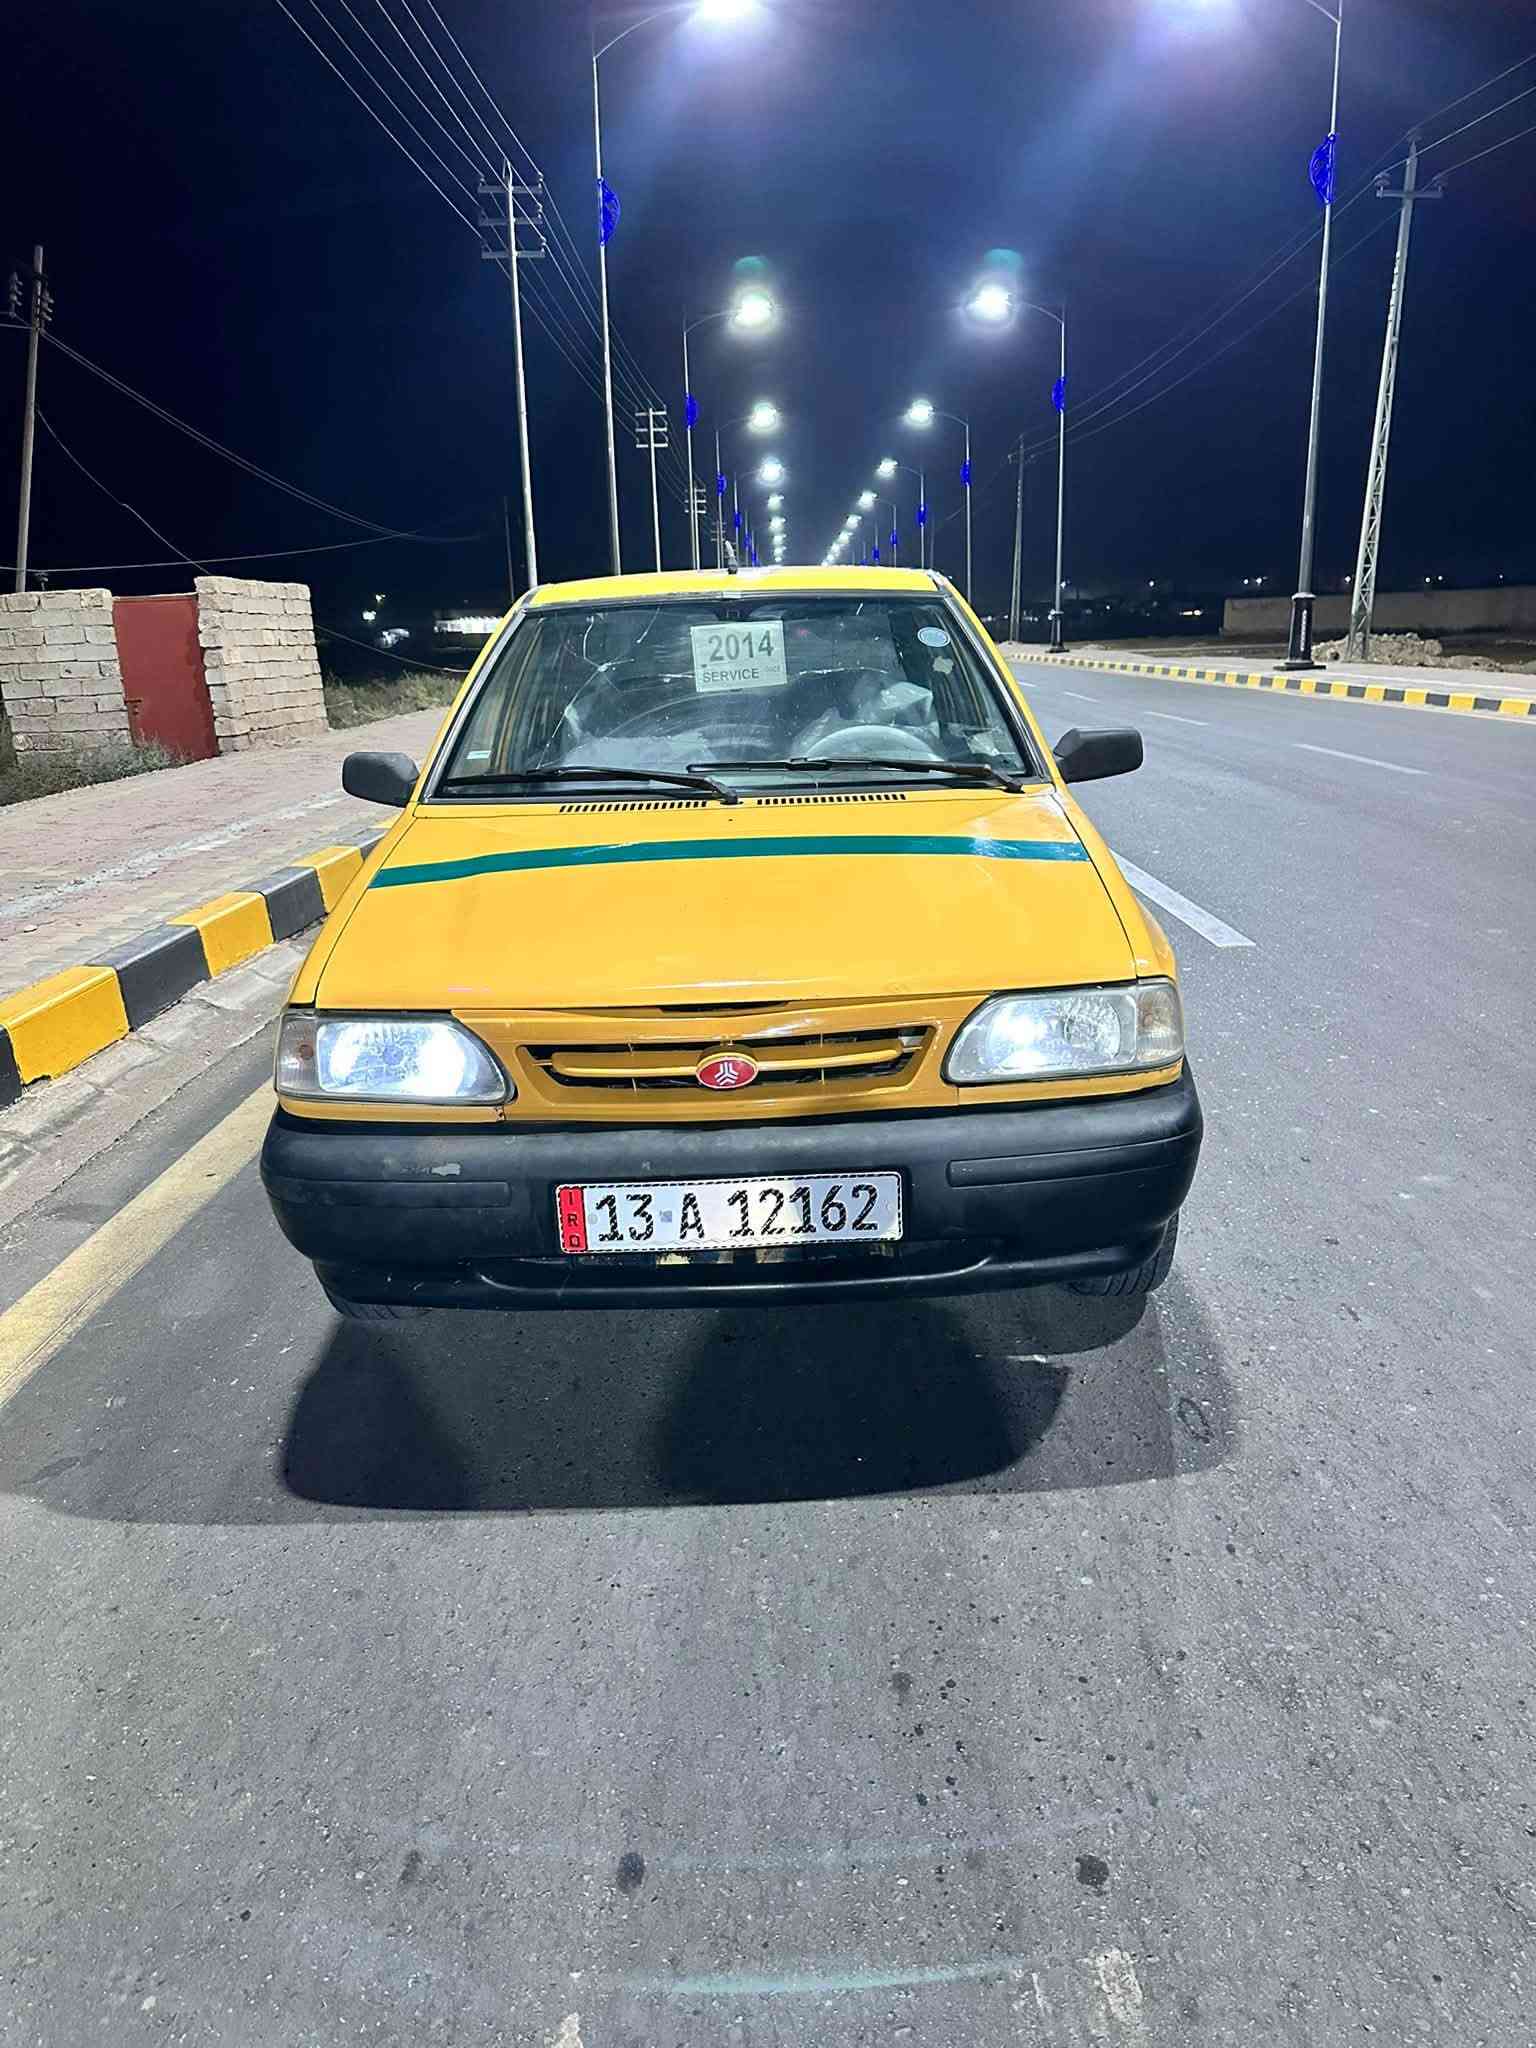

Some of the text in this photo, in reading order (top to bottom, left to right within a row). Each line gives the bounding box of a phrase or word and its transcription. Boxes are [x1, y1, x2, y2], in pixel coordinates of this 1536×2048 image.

[708, 630, 774, 661] 2014
[702, 668, 760, 683] SERVICE
[595, 1183, 879, 1242] 13 A 12162
